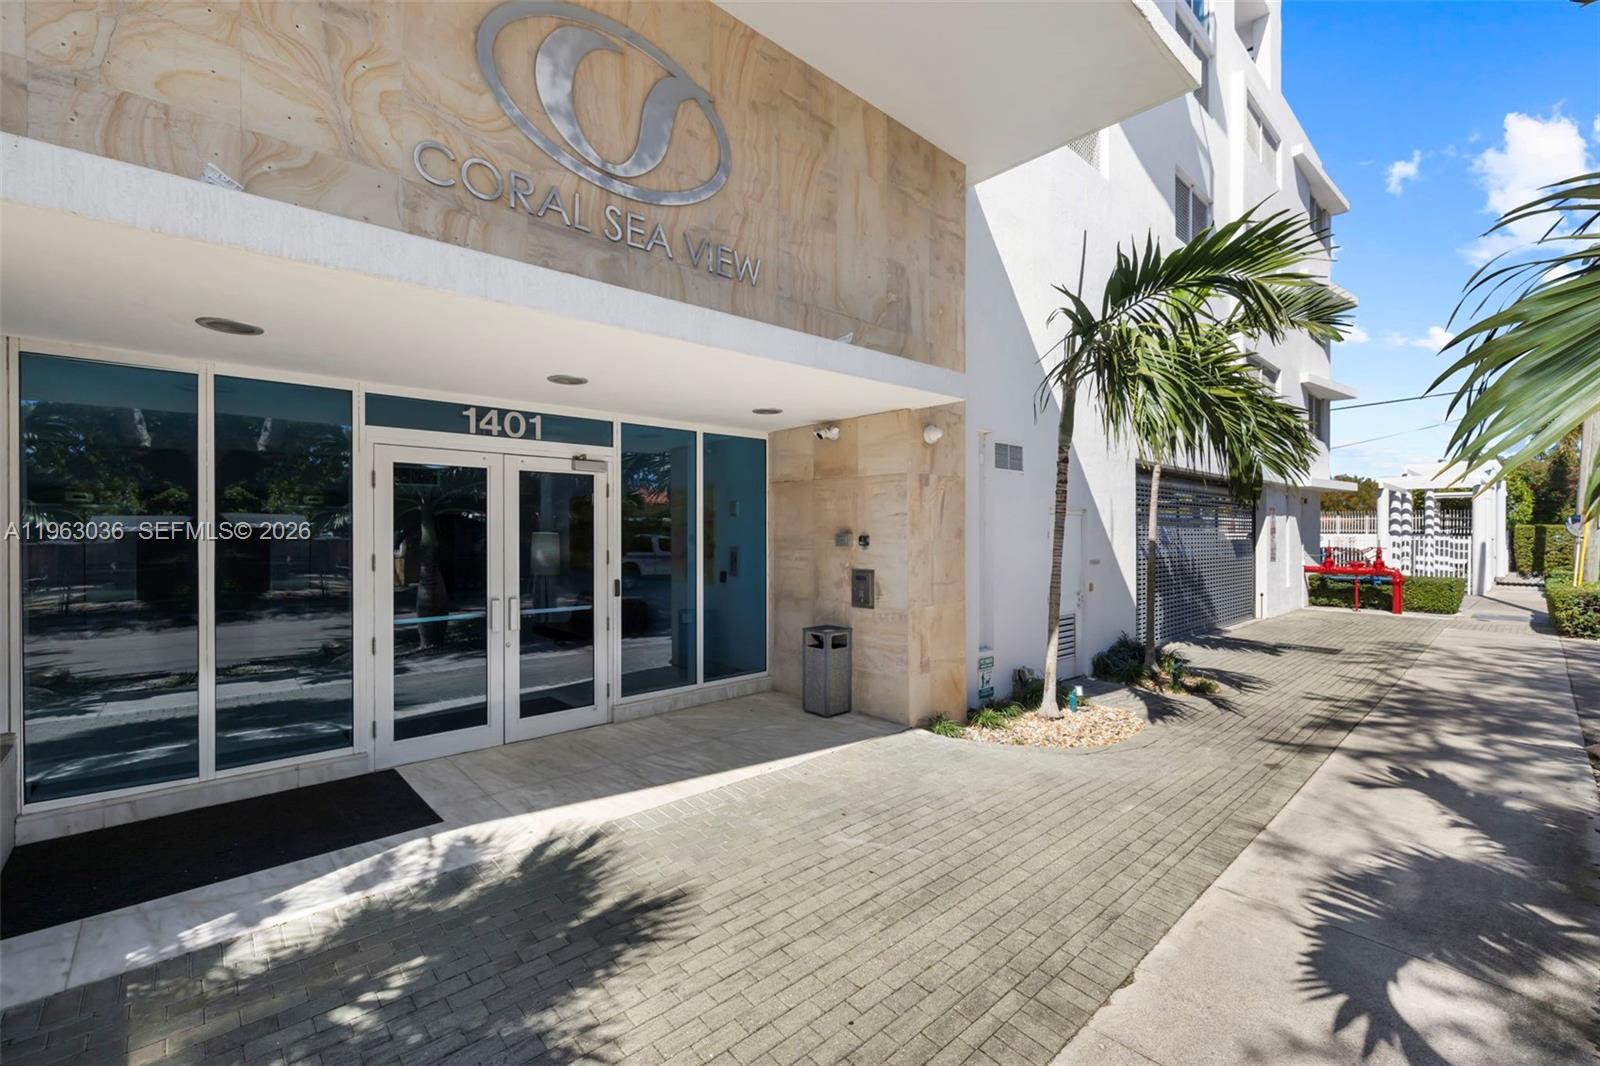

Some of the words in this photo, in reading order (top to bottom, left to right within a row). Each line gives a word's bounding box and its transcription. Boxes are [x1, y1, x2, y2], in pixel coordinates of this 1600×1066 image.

[413, 140, 592, 234] CORAL
[604, 205, 673, 259] SEA
[684, 231, 762, 287] VIEW
[462, 407, 542, 440] 1401
